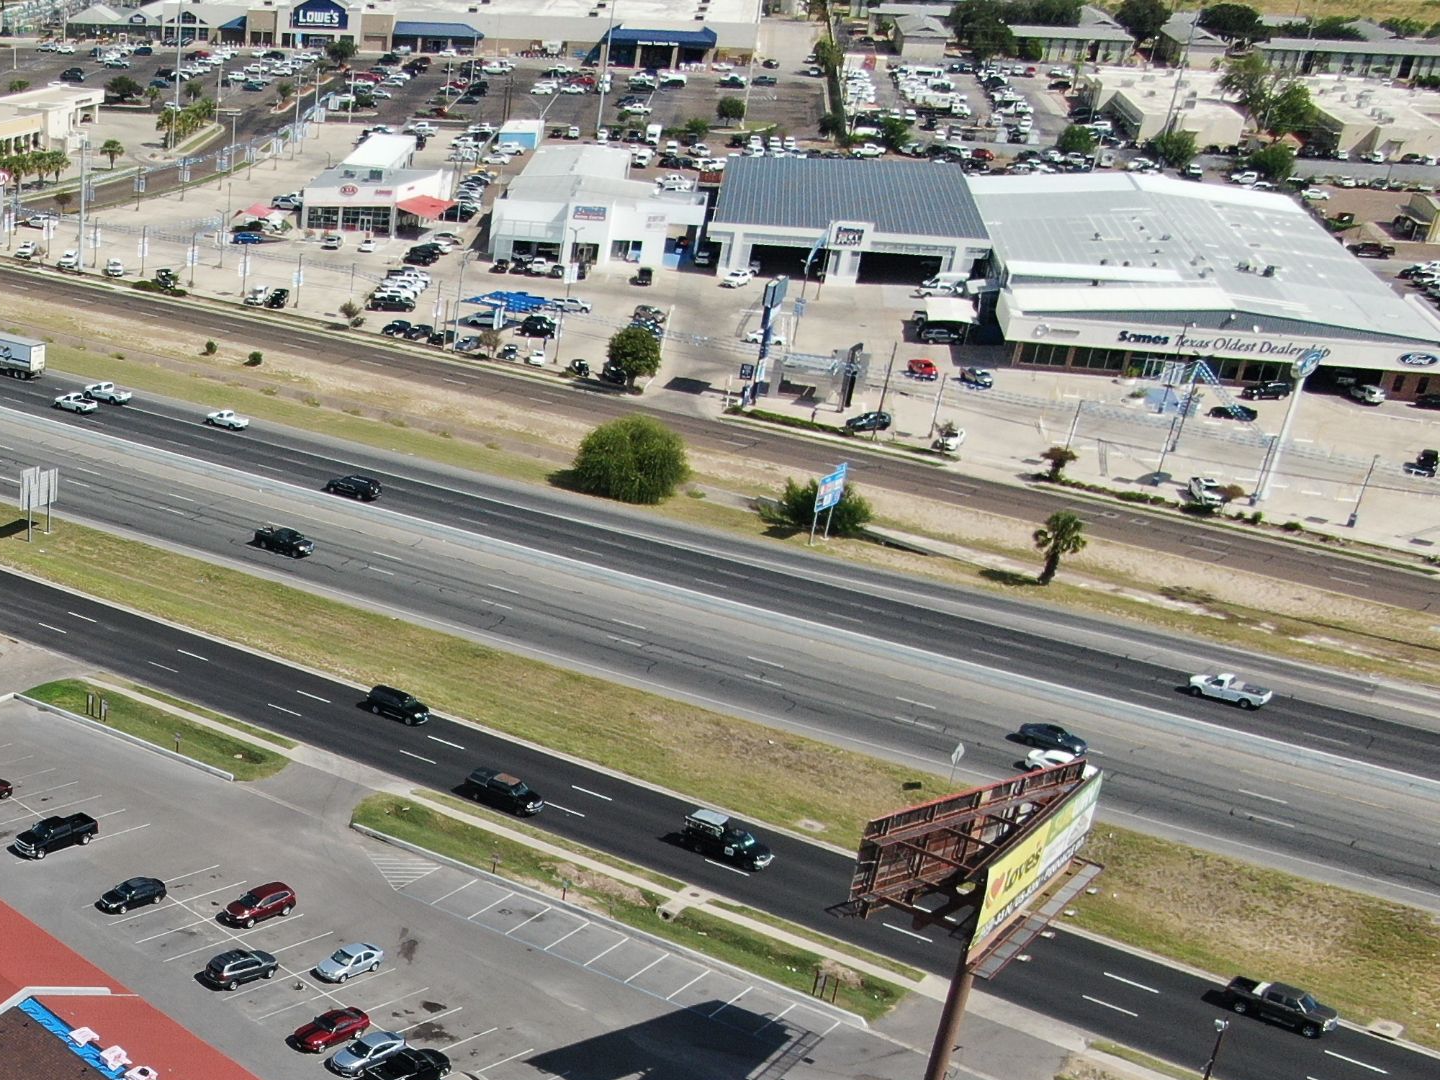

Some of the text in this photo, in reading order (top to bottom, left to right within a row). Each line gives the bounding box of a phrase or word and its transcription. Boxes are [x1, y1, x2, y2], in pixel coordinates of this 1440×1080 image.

[299, 9, 339, 24] LOWE'S
[1175, 334, 1210, 349] Texas
[1214, 338, 1257, 352] Oldest
[1259, 340, 1331, 358] Dealerip
